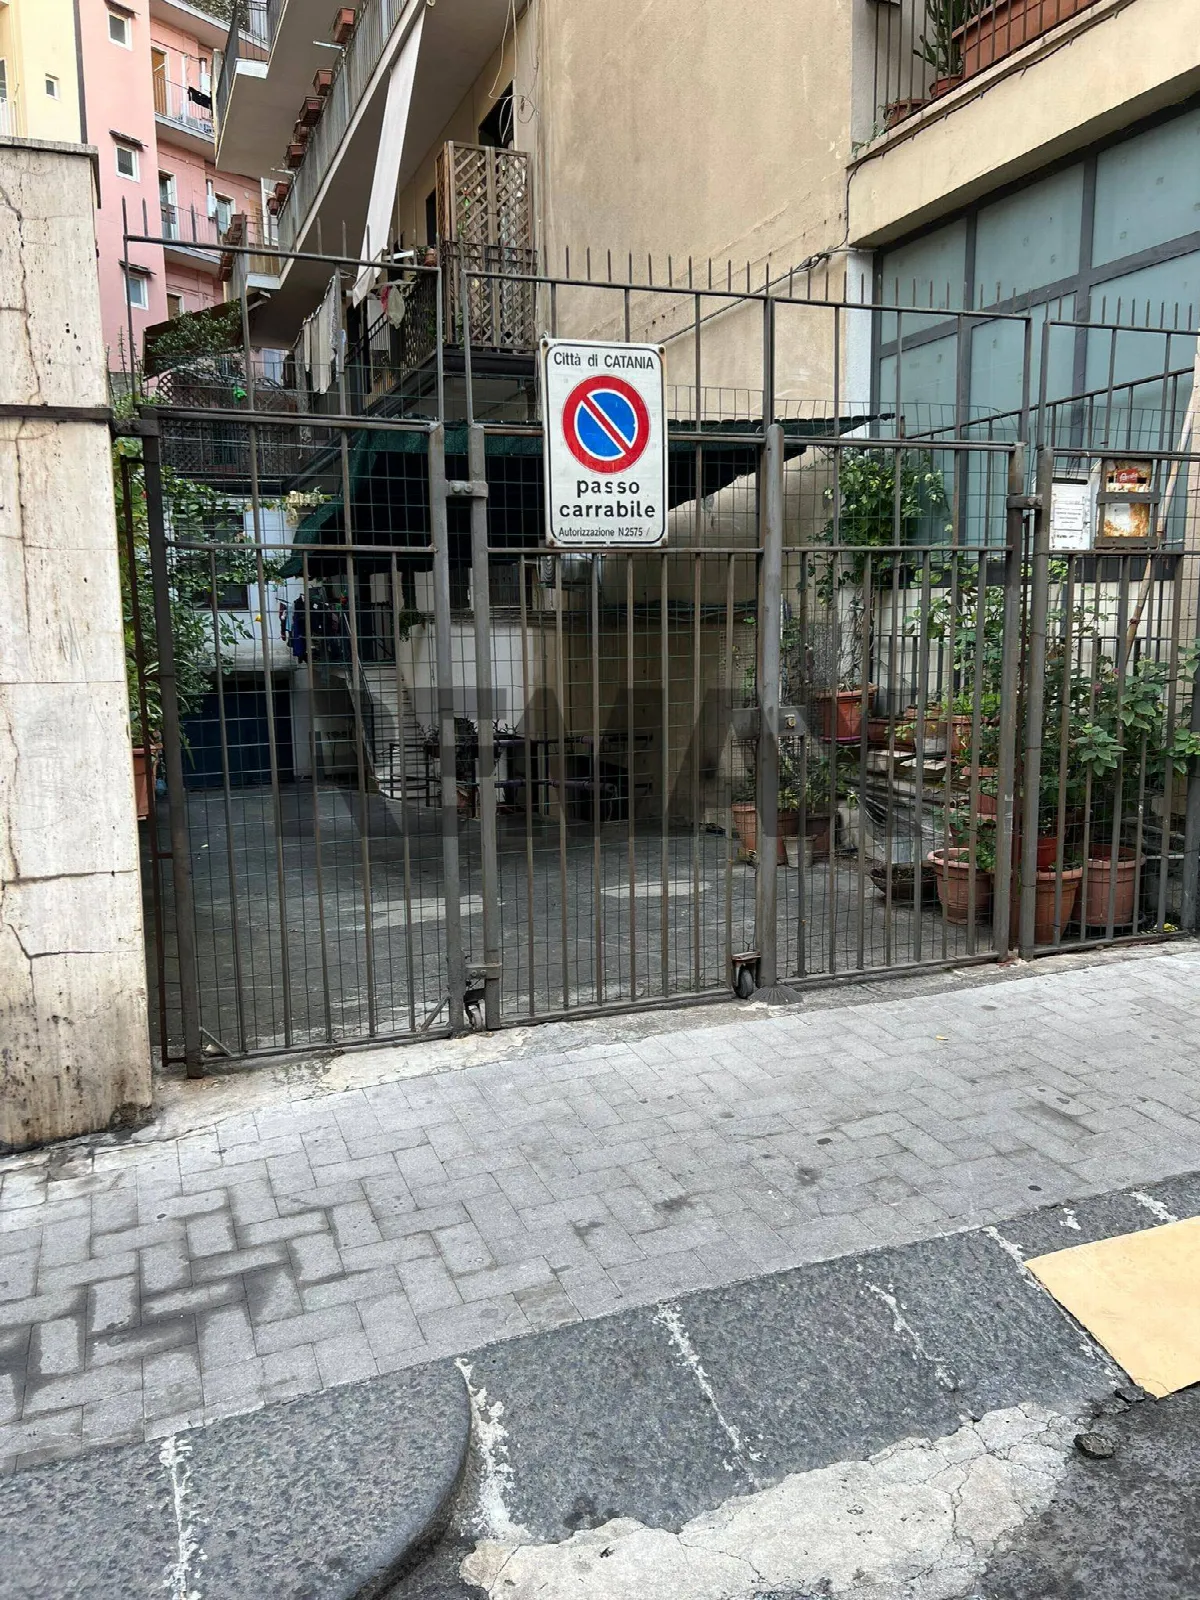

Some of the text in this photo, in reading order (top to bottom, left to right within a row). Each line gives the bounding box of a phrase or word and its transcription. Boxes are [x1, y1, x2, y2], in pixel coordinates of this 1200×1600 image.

[553, 352, 655, 370] Città di CATANIA
[577, 480, 640, 498] passo
[559, 500, 656, 518] carrabile
[558, 527, 615, 538] Autorizzazione
